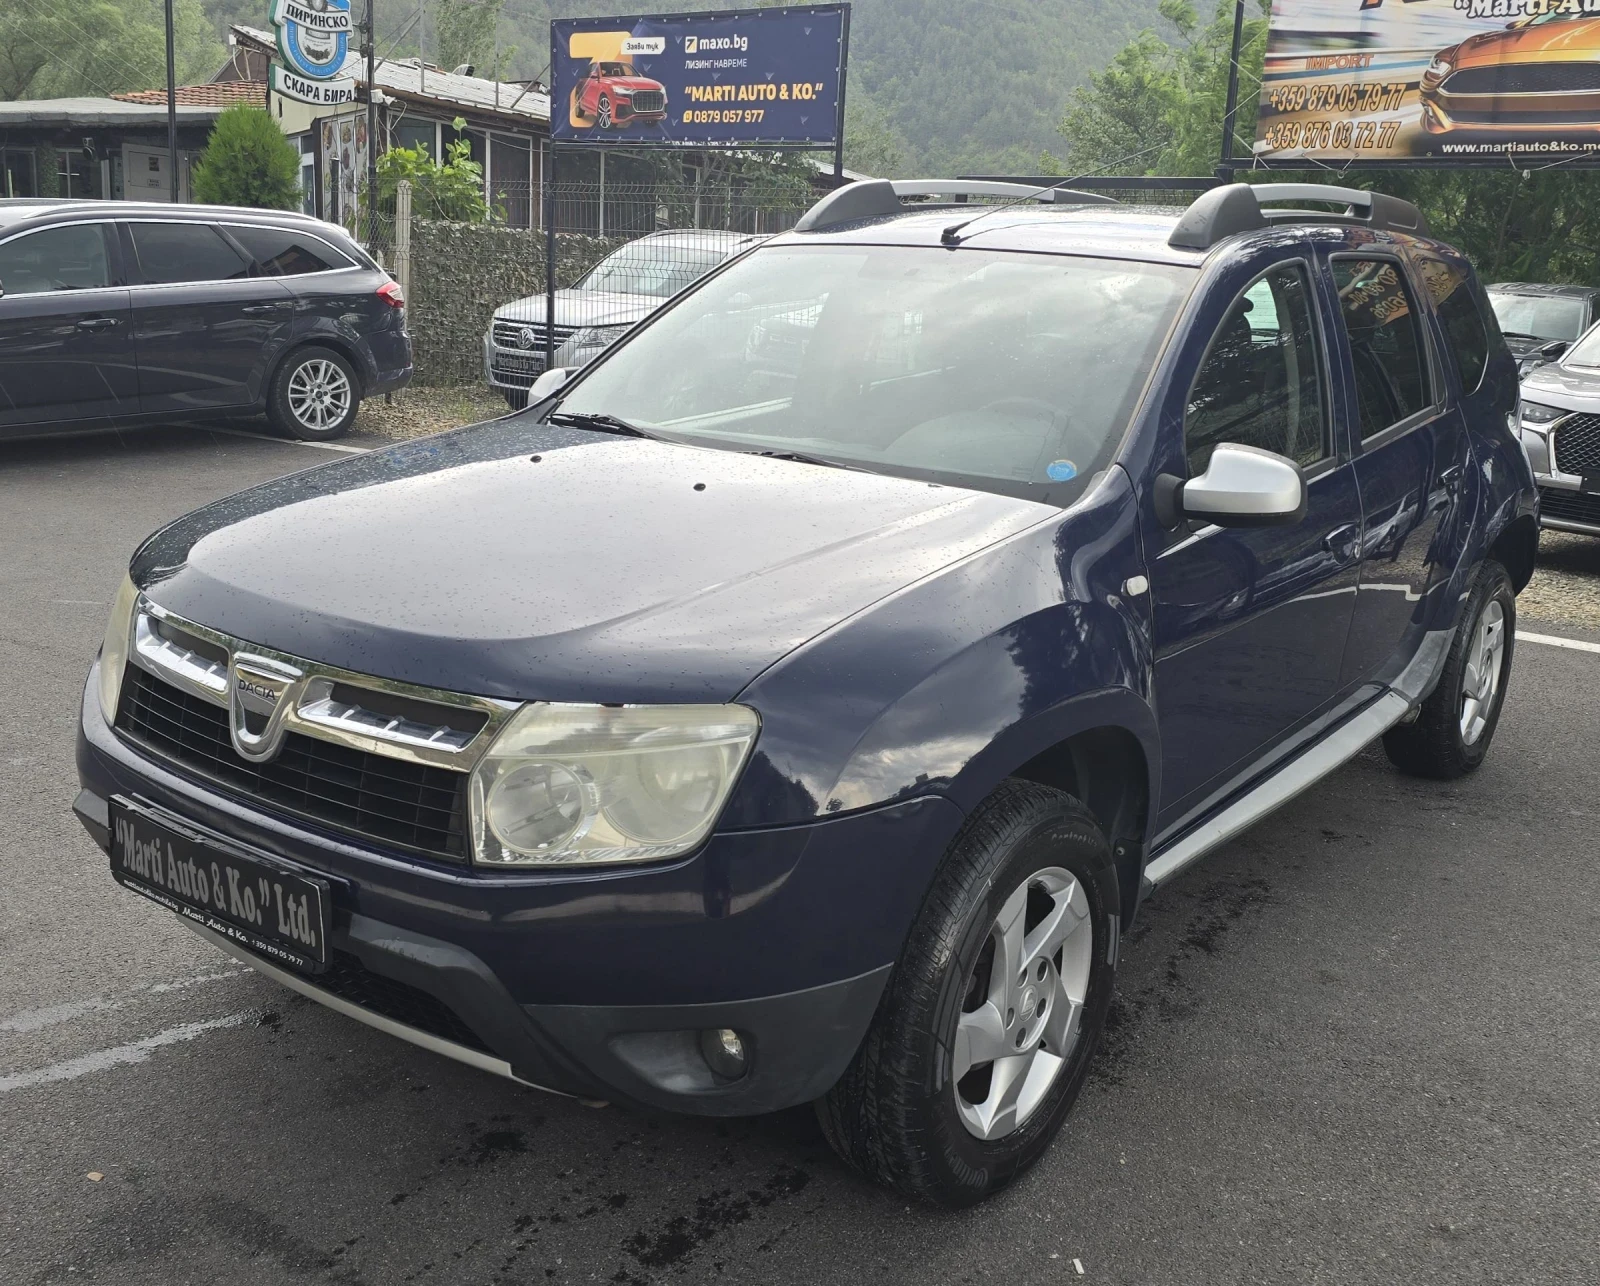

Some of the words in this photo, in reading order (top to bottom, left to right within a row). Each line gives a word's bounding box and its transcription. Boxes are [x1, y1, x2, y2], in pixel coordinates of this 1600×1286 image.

[286, 3, 348, 28] ПИРИНСКО
[626, 42, 645, 51] Заяви
[646, 42, 659, 51] тук
[700, 34, 748, 51] maxo.bg
[684, 59, 712, 69] ЛИЗИНГ
[713, 58, 747, 69] НАВРЕМЕ
[1306, 54, 1374, 70] IMPORT
[283, 74, 320, 100] СКАРА
[324, 88, 352, 102] БИРА
[737, 84, 776, 101] AUTO
[779, 83, 789, 100] &
[1270, 84, 1306, 111] +359
[1307, 84, 1337, 111] 879
[1338, 83, 1361, 112] 05
[1360, 83, 1382, 112] 79
[1384, 83, 1407, 111] 77
[694, 110, 720, 123] 0879
[722, 110, 743, 123] 057
[744, 109, 764, 123] 977
[1265, 121, 1301, 149] +359
[1301, 121, 1332, 149] 876
[1332, 121, 1354, 149] 03
[1354, 121, 1376, 149] 72
[1377, 121, 1402, 149] 77
[238, 680, 276, 701] DACIA
[167, 842, 209, 904] Auto
[211, 861, 227, 912] &
[274, 883, 316, 948] Ltd.
[182, 907, 205, 923] Marti
[206, 918, 226, 933] Auto
[227, 927, 235, 937] &
[235, 929, 249, 943] Ko.
[252, 939, 267, 950] +359
[267, 945, 279, 955] 879
[279, 949, 287, 959] 05
[288, 954, 296, 963] 79
[296, 958, 304, 966] 77
